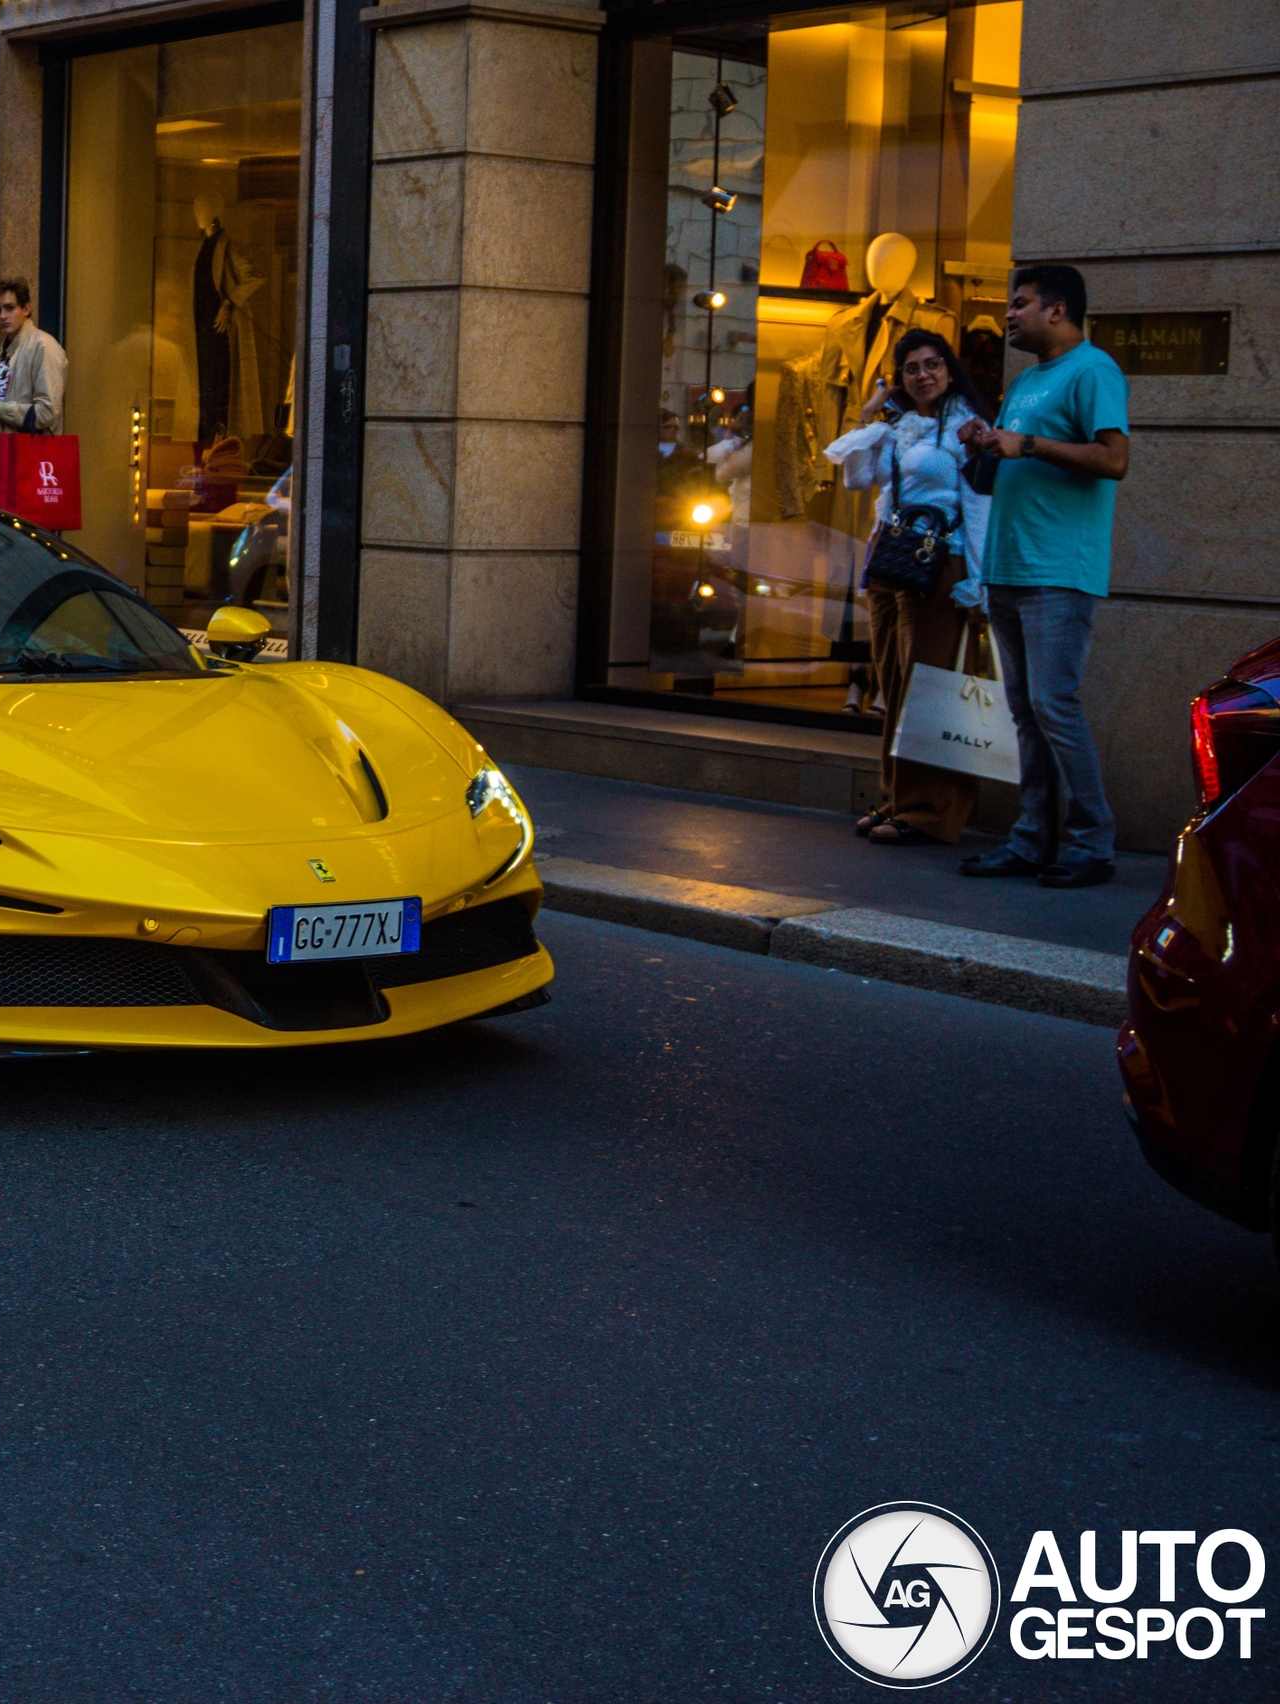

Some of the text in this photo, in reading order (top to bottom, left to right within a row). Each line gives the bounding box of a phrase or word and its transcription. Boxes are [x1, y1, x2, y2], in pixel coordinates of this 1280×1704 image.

[1114, 328, 1203, 346] BALMAIN
[1140, 351, 1174, 360] PARIS
[942, 731, 993, 749] BALLY
